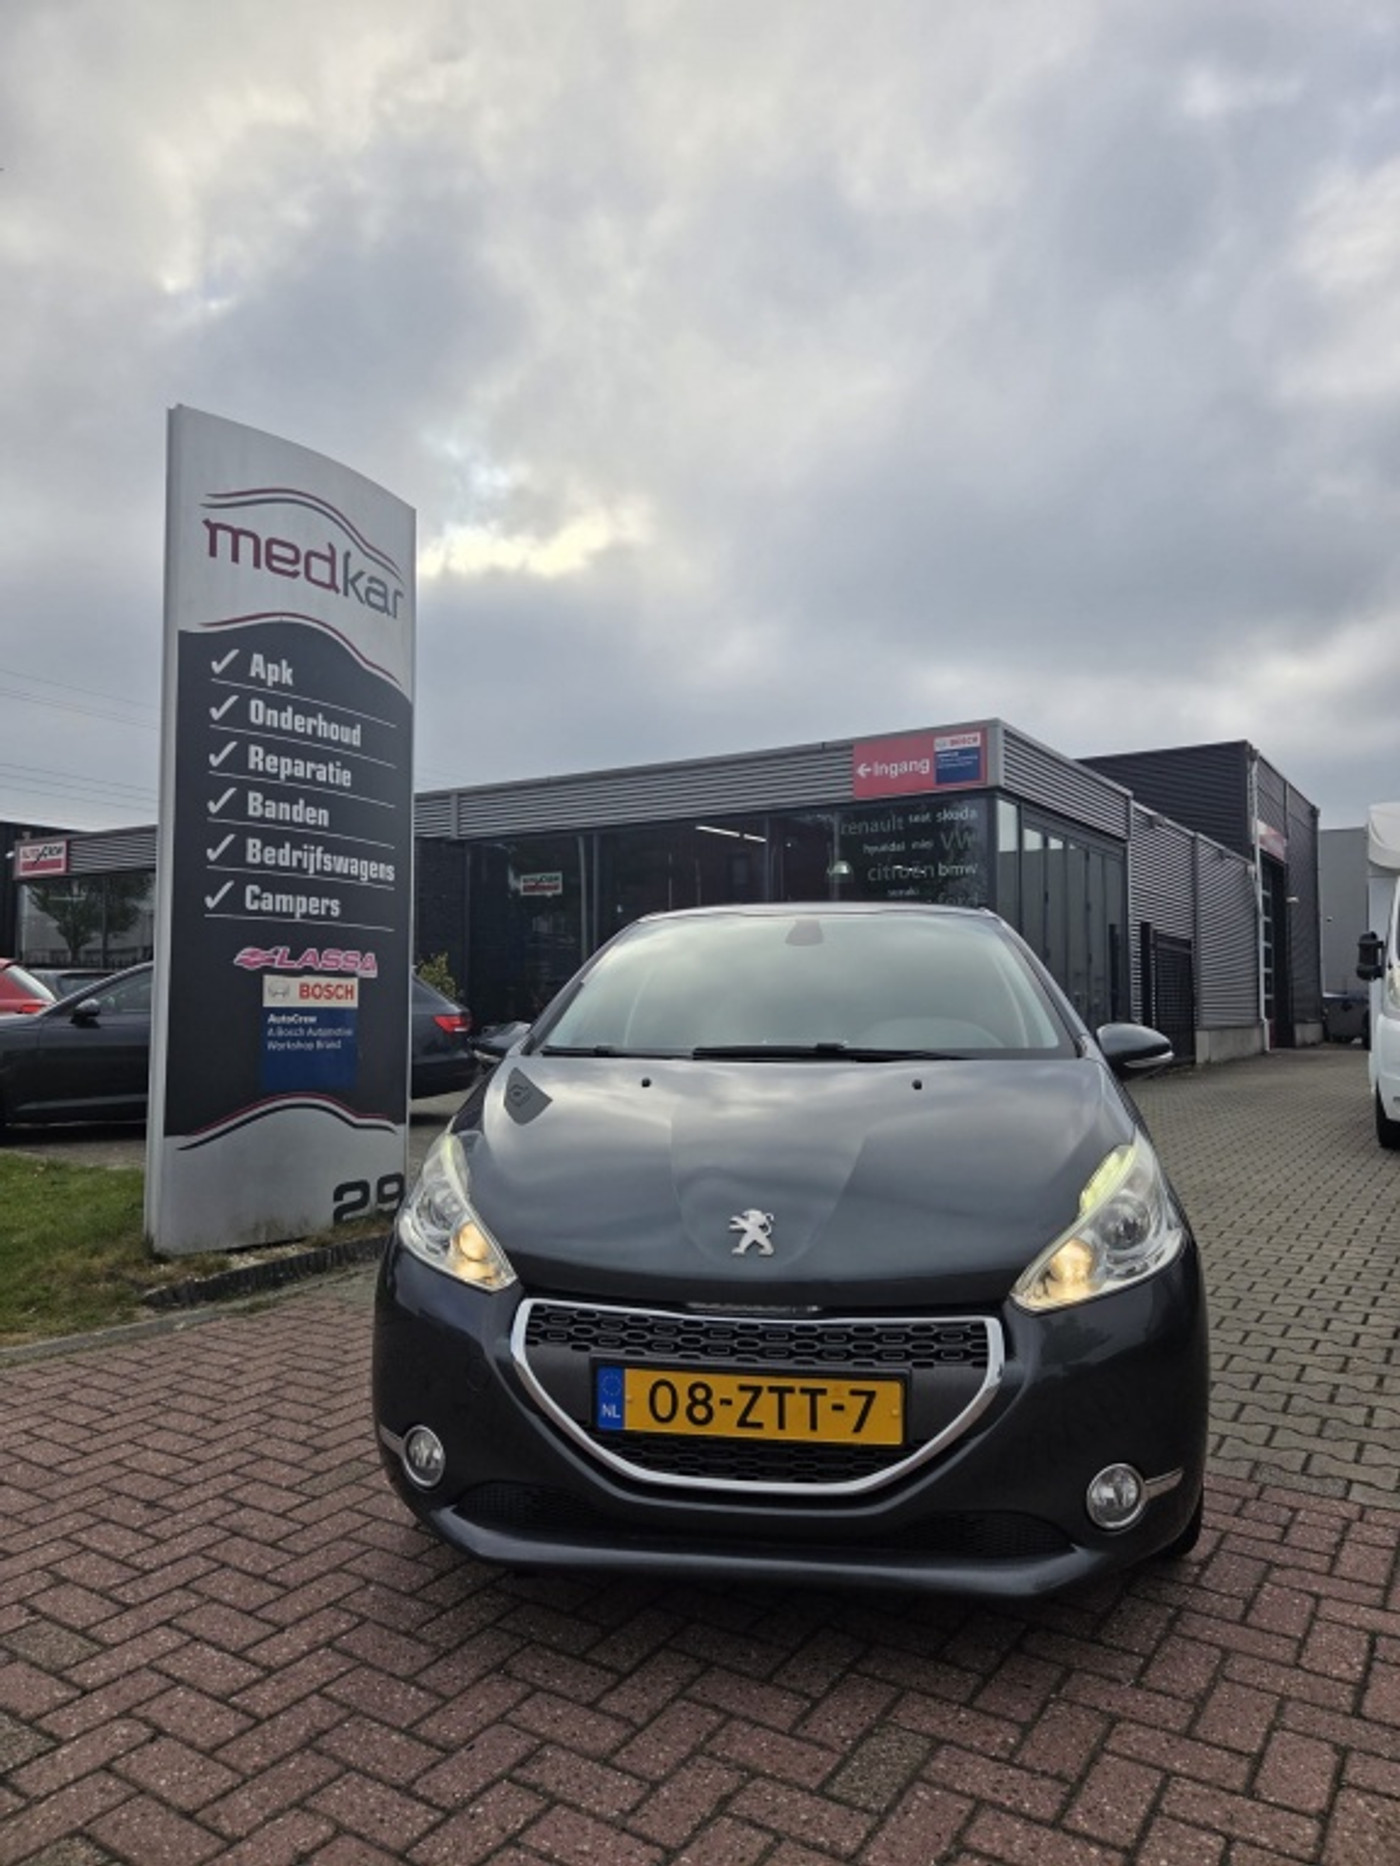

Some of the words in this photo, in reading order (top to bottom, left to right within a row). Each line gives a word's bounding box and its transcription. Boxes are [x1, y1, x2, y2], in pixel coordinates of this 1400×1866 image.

[202, 518, 404, 619] medkar
[250, 653, 294, 687] Apk
[250, 698, 361, 747] Onderhoud
[248, 744, 352, 787] Reparatie
[873, 758, 930, 778] Ingang
[247, 791, 330, 827] Banden
[246, 838, 395, 881] Bedrijfswagens
[245, 884, 341, 920] Campers
[275, 946, 378, 978] LASSA
[299, 983, 354, 1000] BOSCH
[267, 1013, 317, 1025] AutoCrew
[333, 1172, 405, 1227] 29
[602, 1403, 621, 1419] NL
[648, 1378, 877, 1434] 08-ZTT-7
